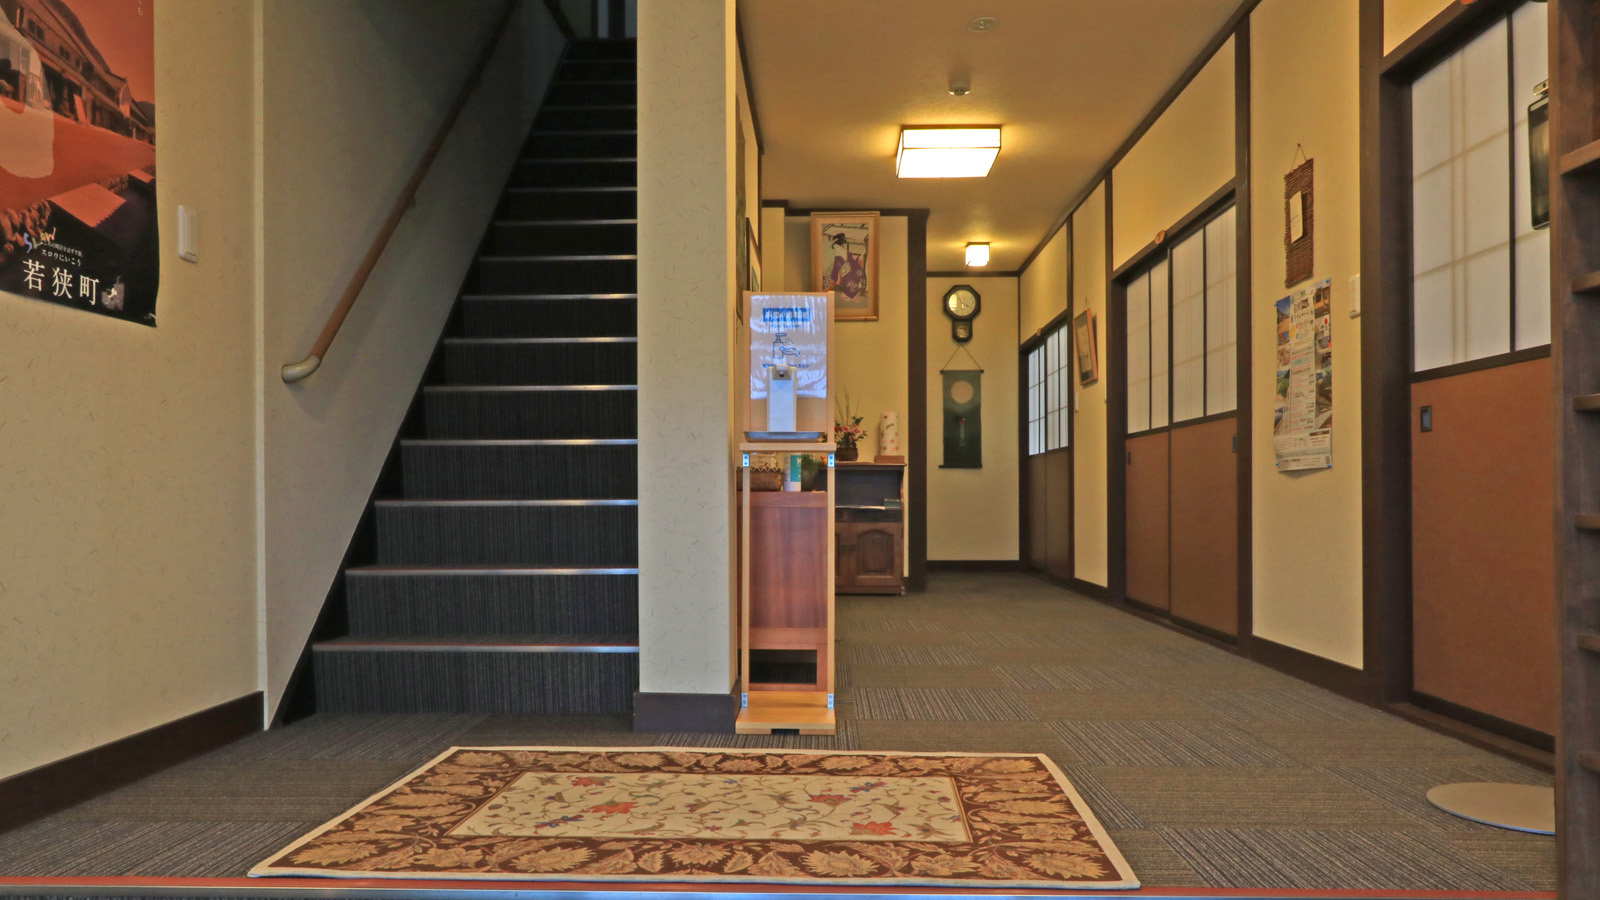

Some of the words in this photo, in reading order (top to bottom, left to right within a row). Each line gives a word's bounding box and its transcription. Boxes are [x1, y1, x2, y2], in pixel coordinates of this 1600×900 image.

[41, 249, 81, 267] スロウにいこう
[22, 259, 100, 306] 若狭町
